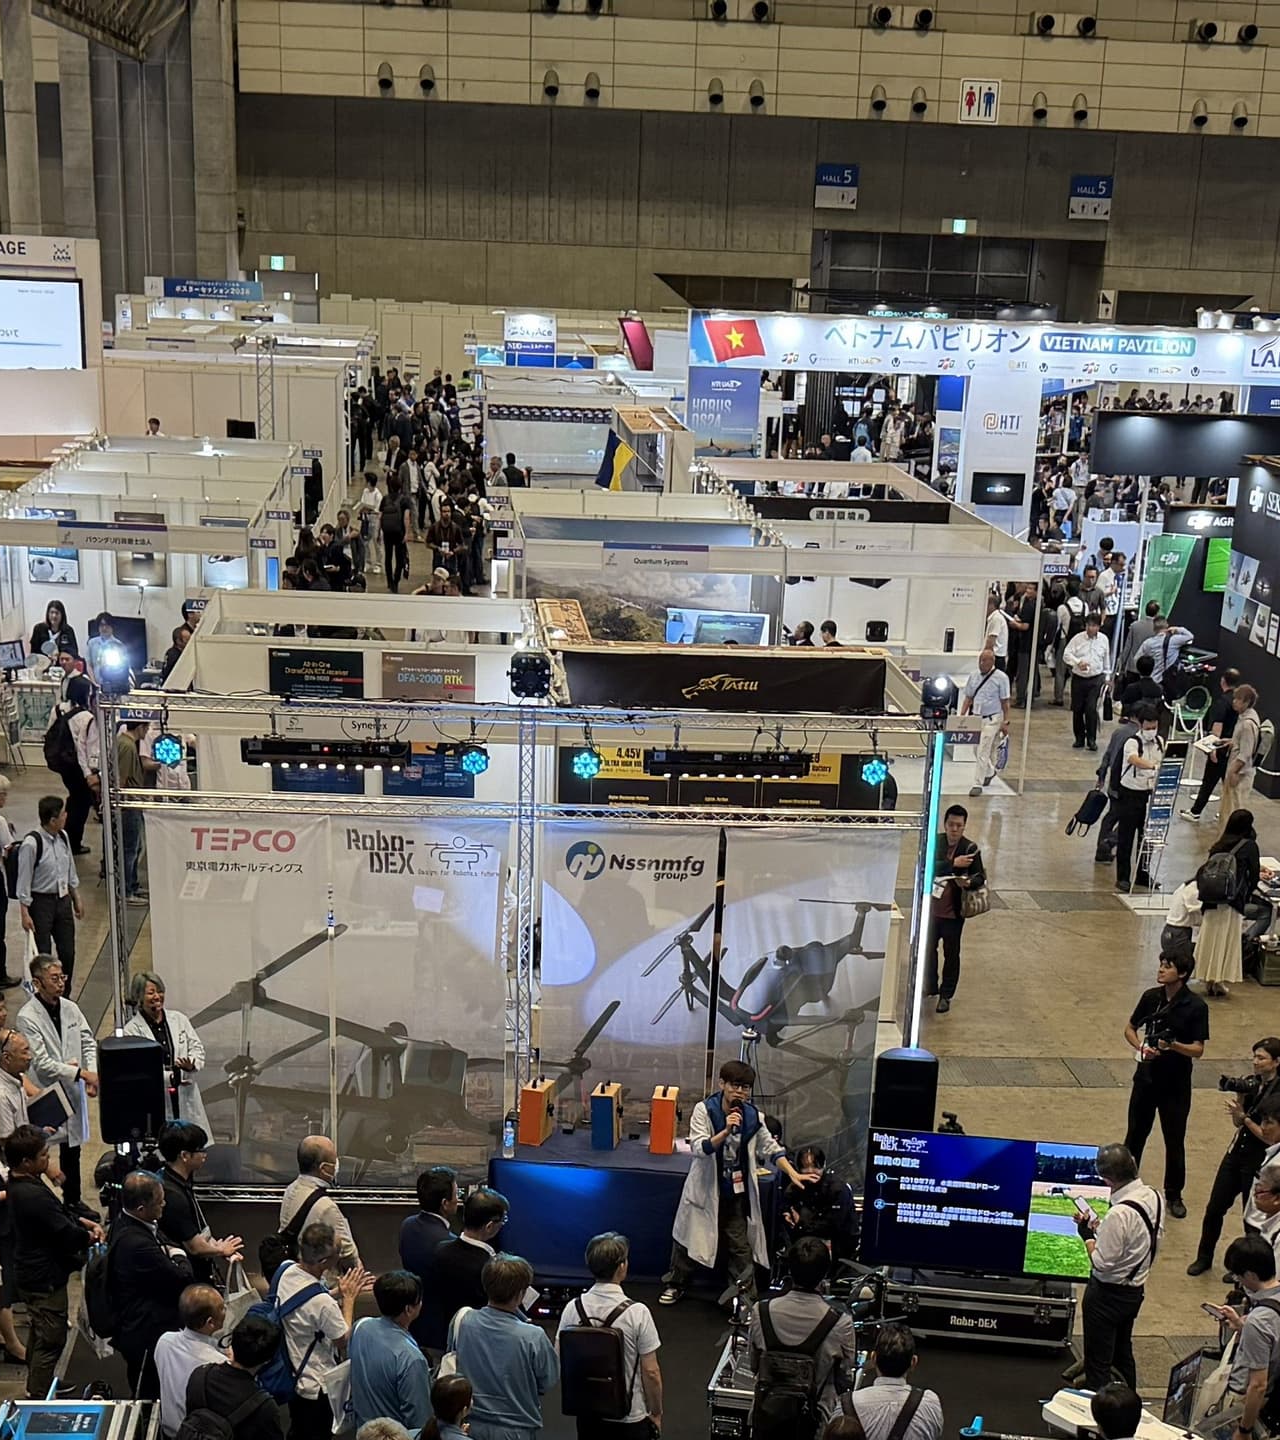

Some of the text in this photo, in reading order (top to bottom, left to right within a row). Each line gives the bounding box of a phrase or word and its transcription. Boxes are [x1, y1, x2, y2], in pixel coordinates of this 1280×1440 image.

[822, 170, 852, 183] HALL 5
[1077, 181, 1107, 194] HALL 5
[824, 323, 1031, 354] ベトナムパビリオン
[1043, 335, 1191, 355] VIETNAM PAVILION
[633, 557, 689, 567] Quantum Systems
[443, 675, 463, 686] RTK
[126, 709, 153, 718] AQ-7
[351, 720, 388, 732] Synerx
[950, 732, 974, 743] AP-7
[616, 747, 641, 760] 4.45V
[190, 827, 297, 853] TEPCO
[345, 828, 415, 854] Robo-
[185, 861, 304, 874] 東京電力ホールディングス
[368, 853, 415, 875] DEX
[608, 853, 705, 877] Nssnmfg
[653, 871, 689, 882] group
[949, 1315, 998, 1329] Robo-DEX
